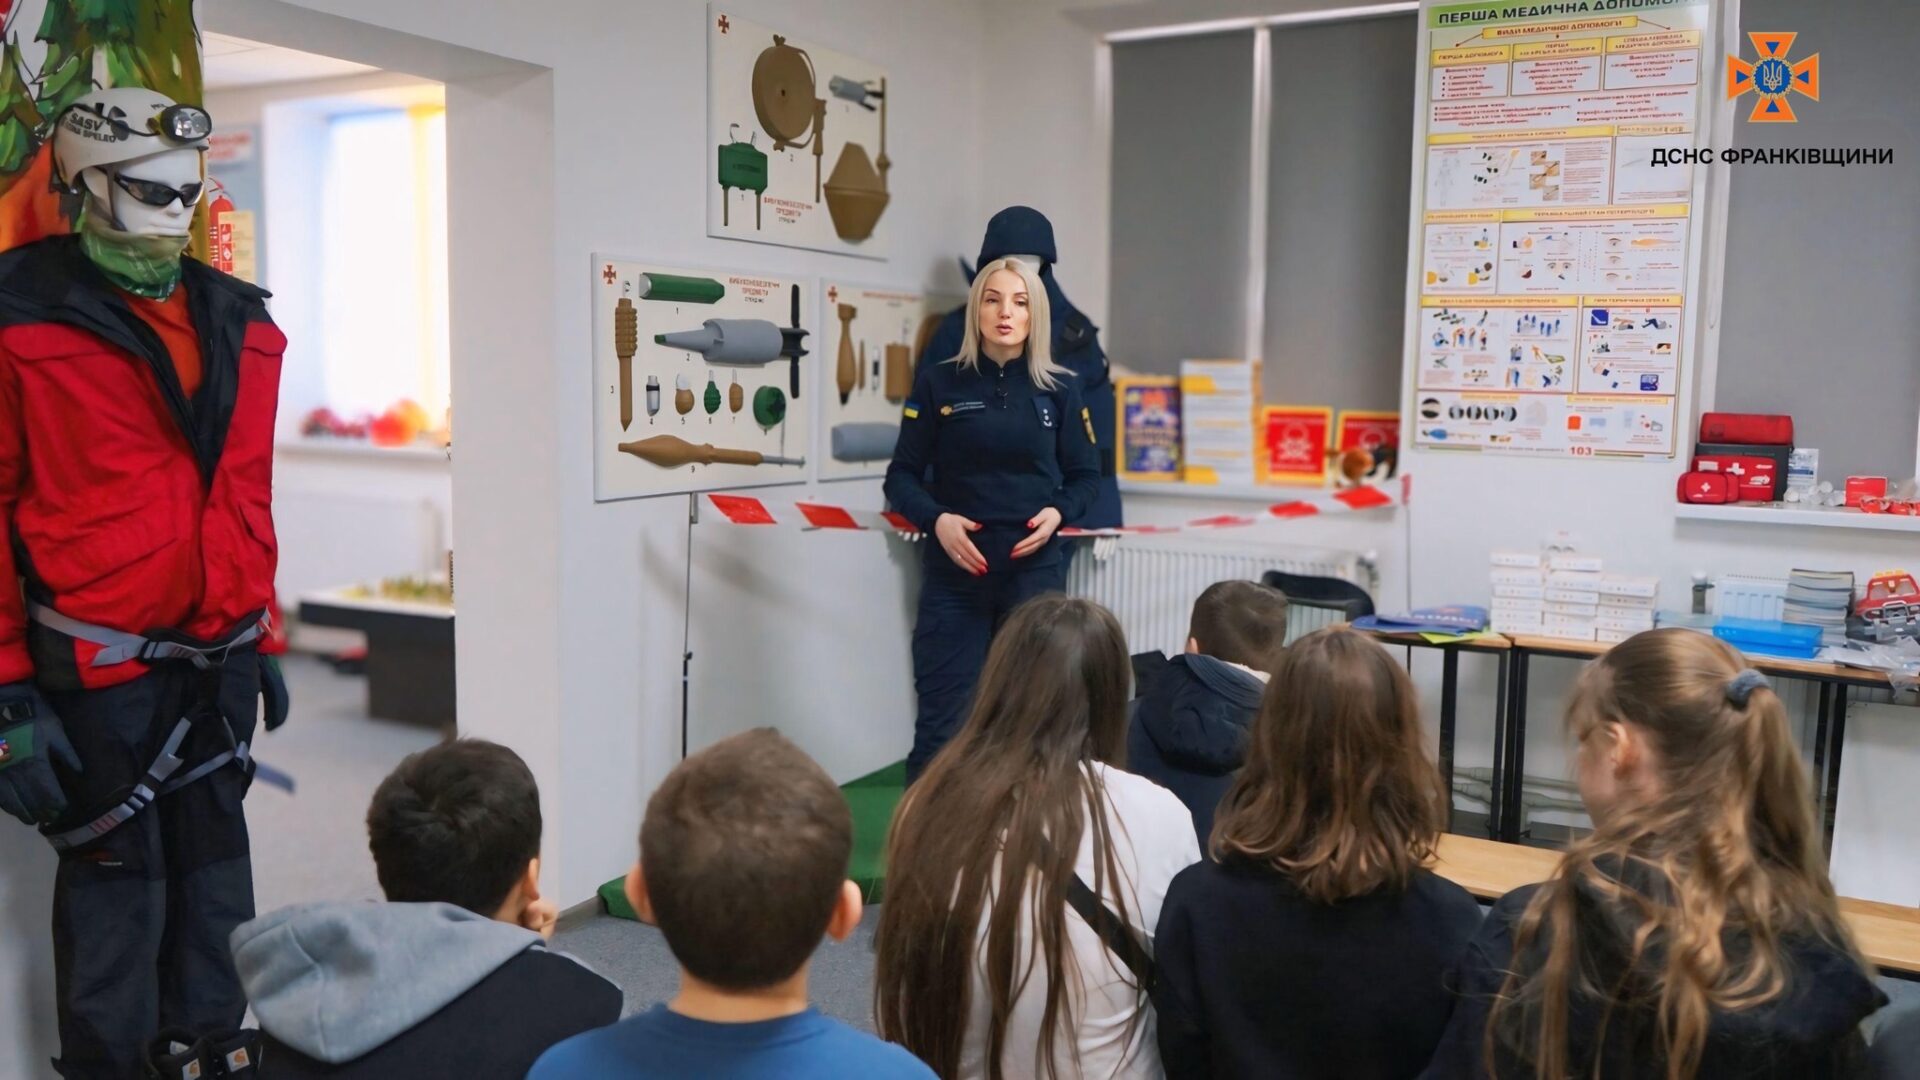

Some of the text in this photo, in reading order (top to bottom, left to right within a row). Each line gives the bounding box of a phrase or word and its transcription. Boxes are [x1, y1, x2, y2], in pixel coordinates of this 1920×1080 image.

[1439, 9, 1498, 24] ПЕРША
[1502, 2, 1589, 19] МЕДИЧНА
[1571, 20, 1622, 30] ДОПОМОГИ
[71, 112, 105, 131] SASV
[1570, 446, 1592, 456] 103
